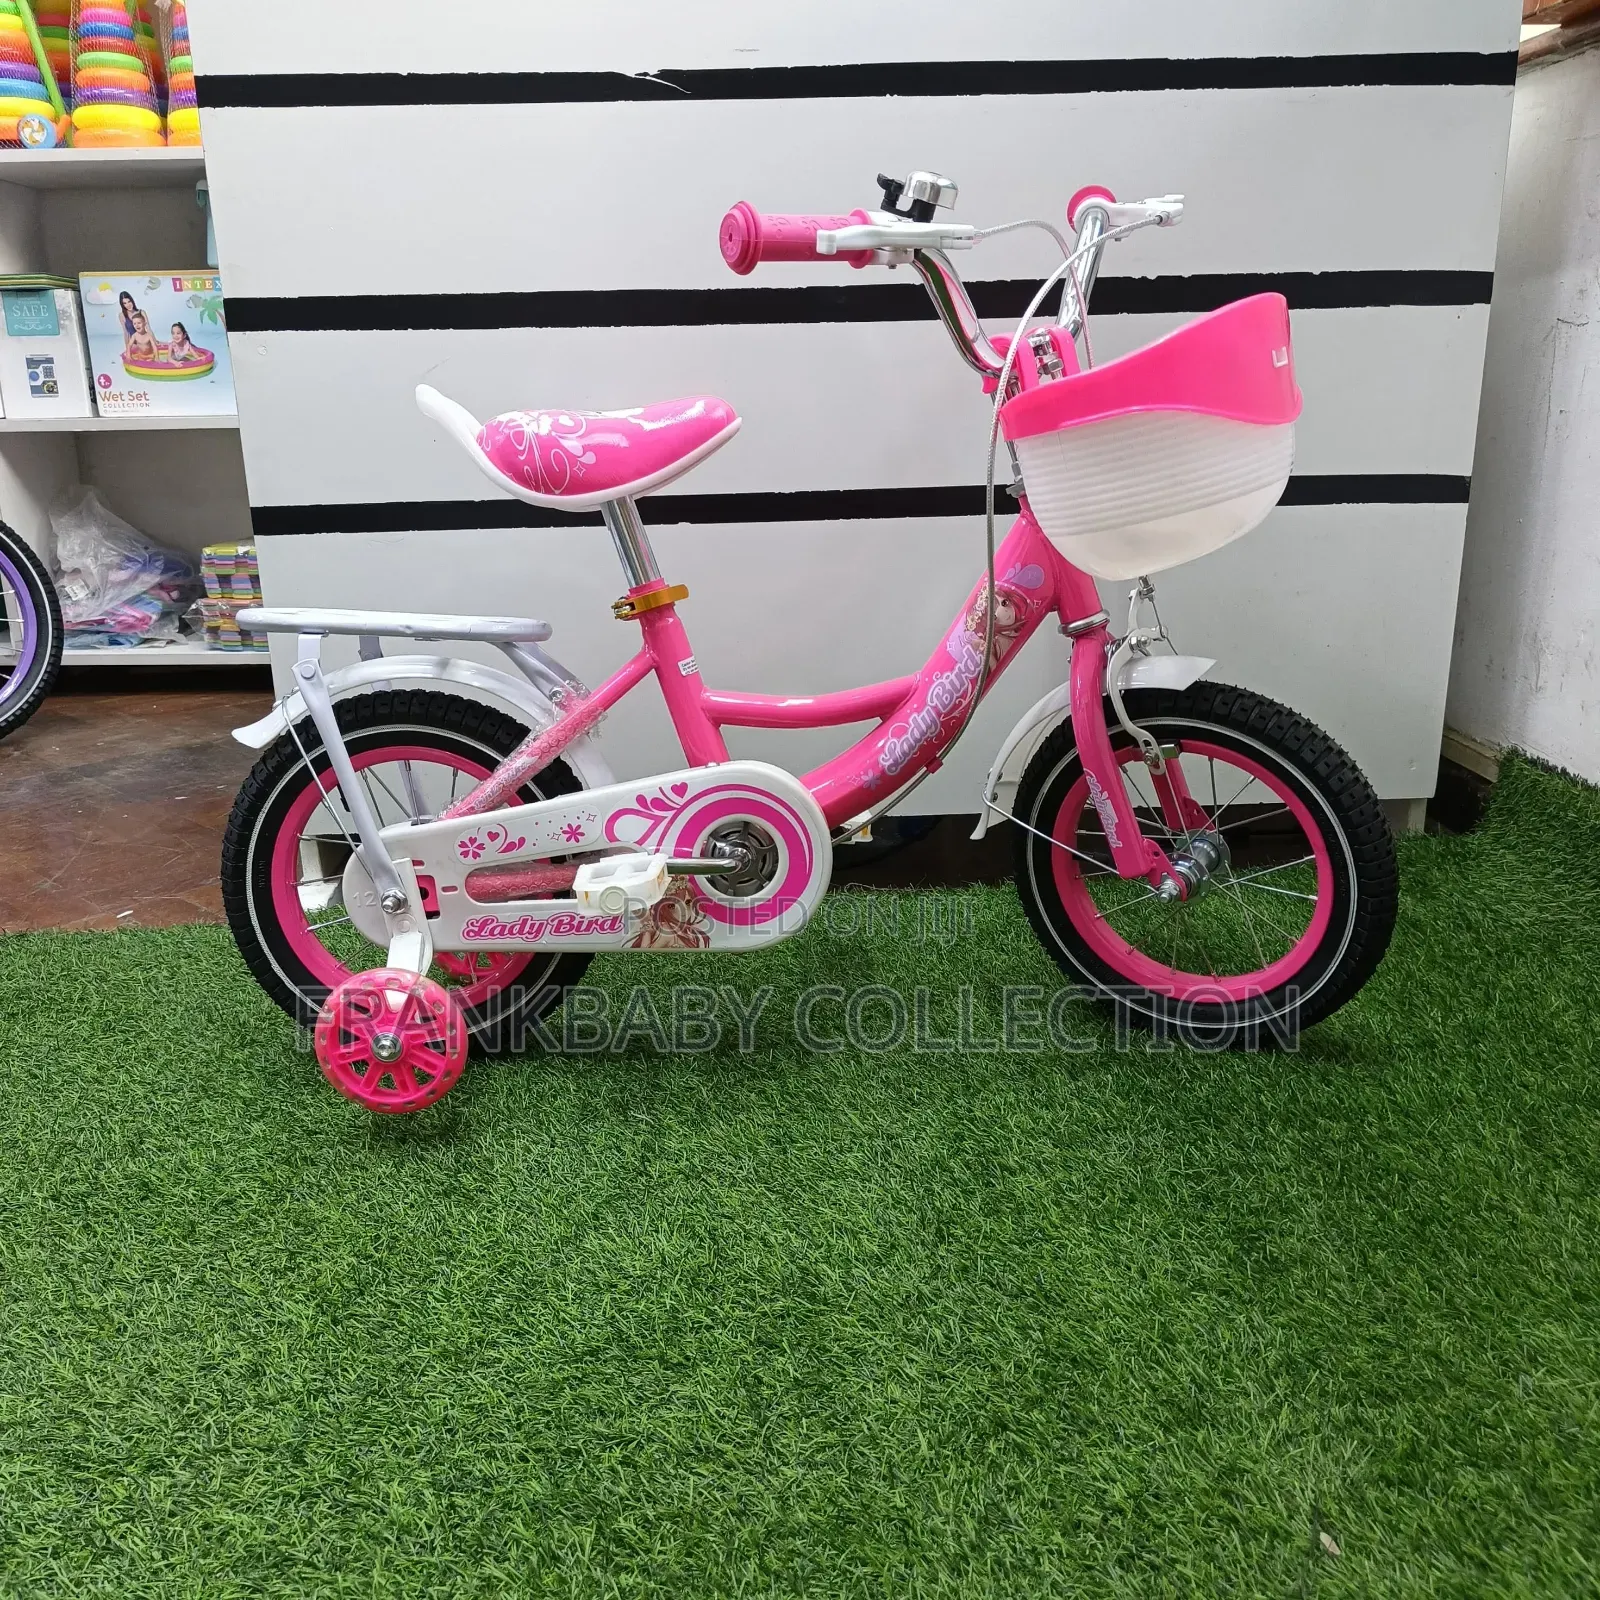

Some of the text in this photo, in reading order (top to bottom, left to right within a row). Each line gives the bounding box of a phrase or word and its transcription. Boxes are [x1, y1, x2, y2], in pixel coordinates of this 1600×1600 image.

[175, 279, 222, 289] INTEX
[12, 304, 49, 317] SAFE
[98, 390, 150, 402] Wet Set
[879, 644, 985, 775] Lady Bird
[353, 890, 377, 909] 12
[462, 911, 625, 943] Lady Bird
